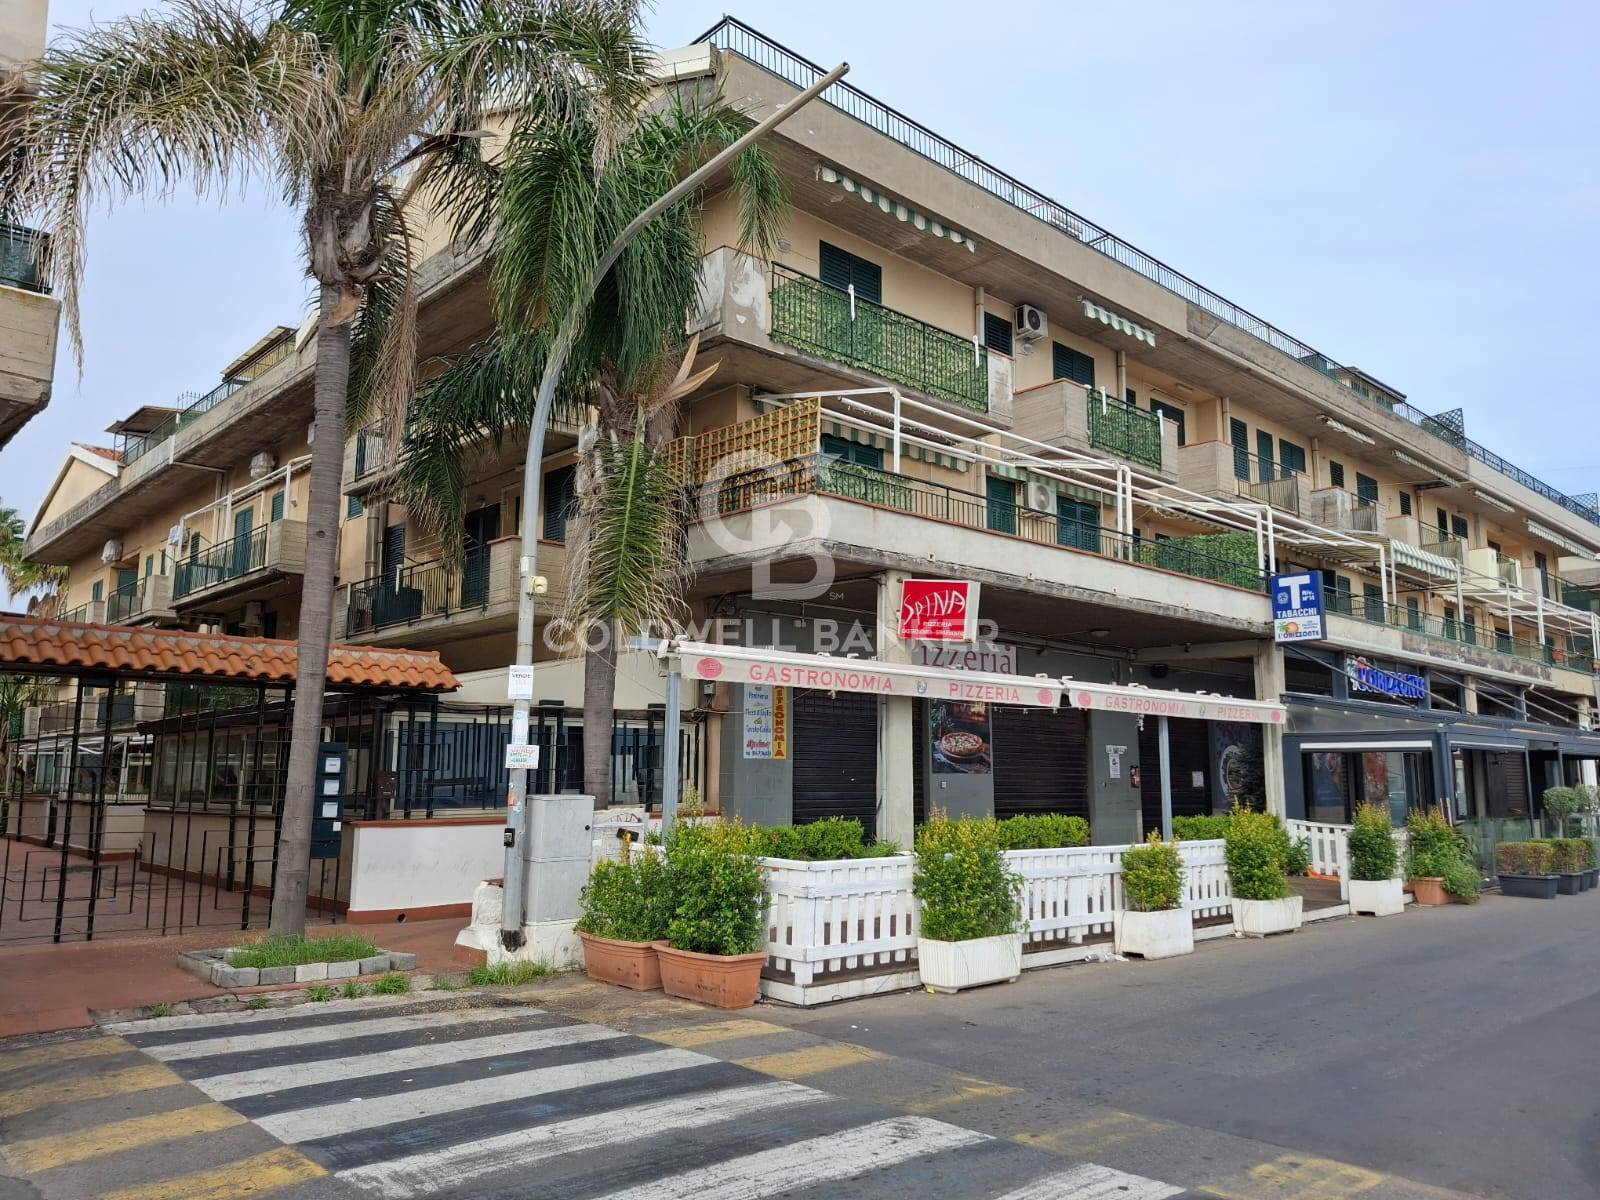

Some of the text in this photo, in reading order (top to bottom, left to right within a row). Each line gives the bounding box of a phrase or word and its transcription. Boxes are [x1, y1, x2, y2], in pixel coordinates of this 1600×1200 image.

[1278, 574, 1310, 609] T
[923, 620, 953, 628] PIZZERIA
[1276, 608, 1317, 618] TABACCHI
[749, 663, 894, 692] GASTRONOMIA
[949, 682, 1020, 702] PIZZERIA
[1105, 695, 1261, 720] GASTRONOMIA PIZZERIA
